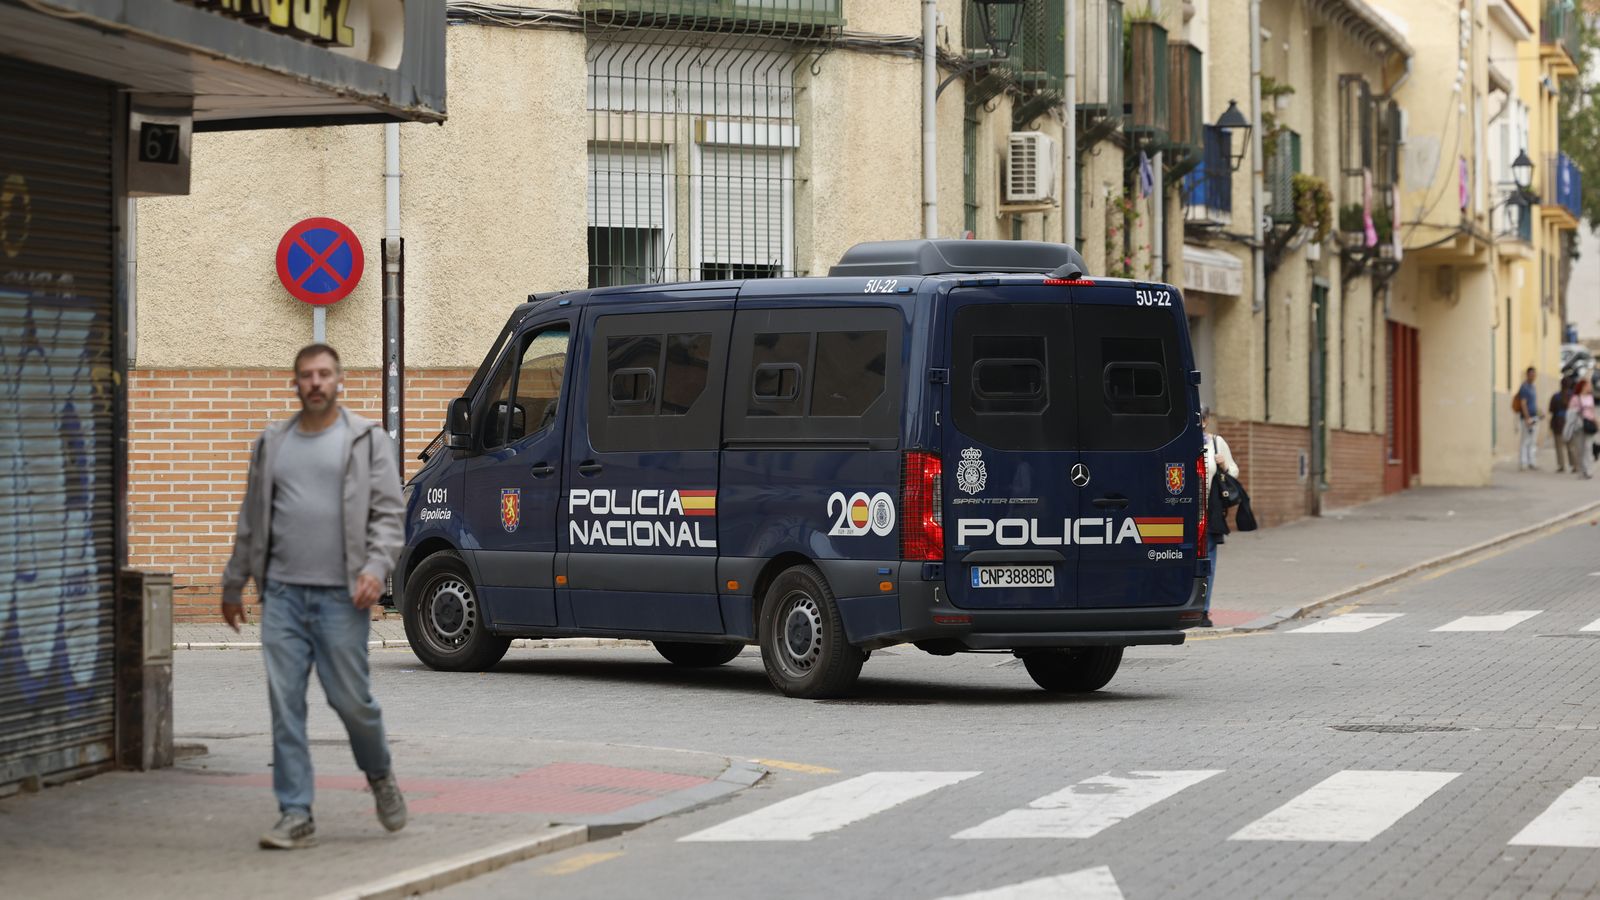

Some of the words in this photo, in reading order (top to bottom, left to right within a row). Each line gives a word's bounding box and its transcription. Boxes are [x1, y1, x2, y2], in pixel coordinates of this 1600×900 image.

[145, 128, 178, 161] 67
[864, 279, 898, 293] 5U-22
[1136, 290, 1172, 306] 5U-22
[432, 488, 448, 503] 091
[569, 489, 685, 516] POLICÍA
[420, 508, 452, 522] @policia
[827, 491, 896, 537] 200
[569, 520, 717, 548] NACIONAL
[957, 517, 1142, 546] POLICÍA
[1148, 549, 1183, 562] @policia
[980, 568, 1053, 585] CNP3888BC
